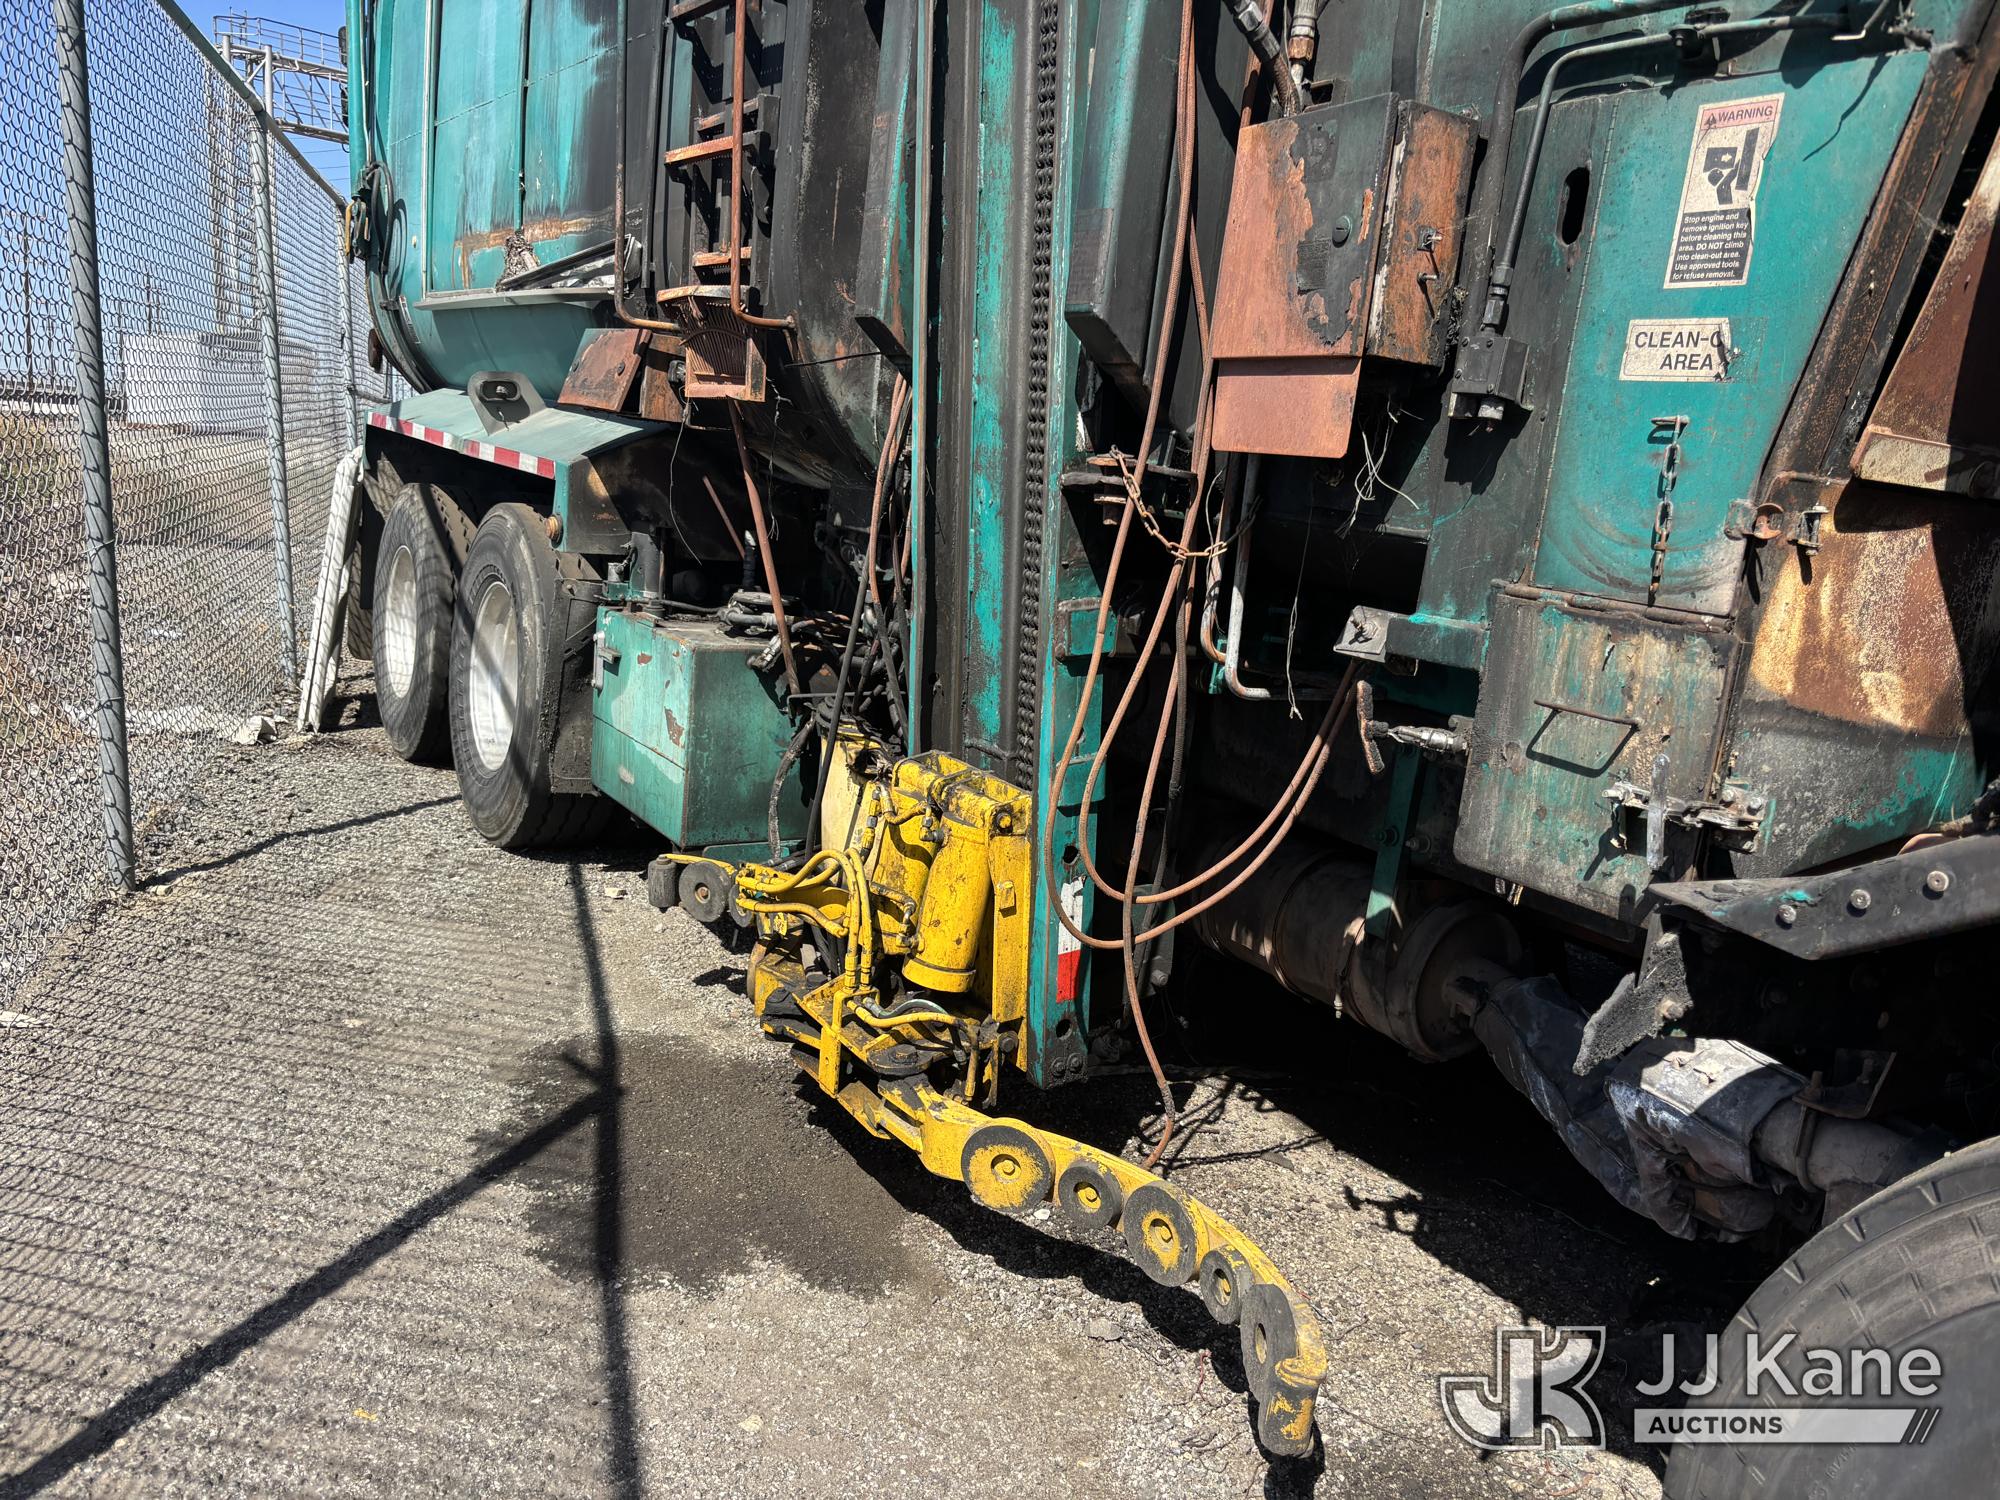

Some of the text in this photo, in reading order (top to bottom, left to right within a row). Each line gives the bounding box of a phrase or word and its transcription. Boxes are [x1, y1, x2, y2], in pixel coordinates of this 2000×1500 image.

[1718, 106, 1773, 122] WARNING
[1684, 212, 1739, 224] Stop engine and
[1681, 222, 1748, 233] remove ignition key
[1702, 232, 1732, 241] cleaning
[1733, 231, 1747, 239] this
[1696, 243, 1707, 251] DO
[1707, 242, 1725, 250] NOT
[1724, 240, 1744, 249] climb
[1676, 253, 1690, 261] into
[1690, 251, 1723, 260] clean-out
[1674, 260, 1740, 271] Use approved tools
[1672, 270, 1736, 280] for refuse removal.
[1659, 353, 1713, 370] AREA
